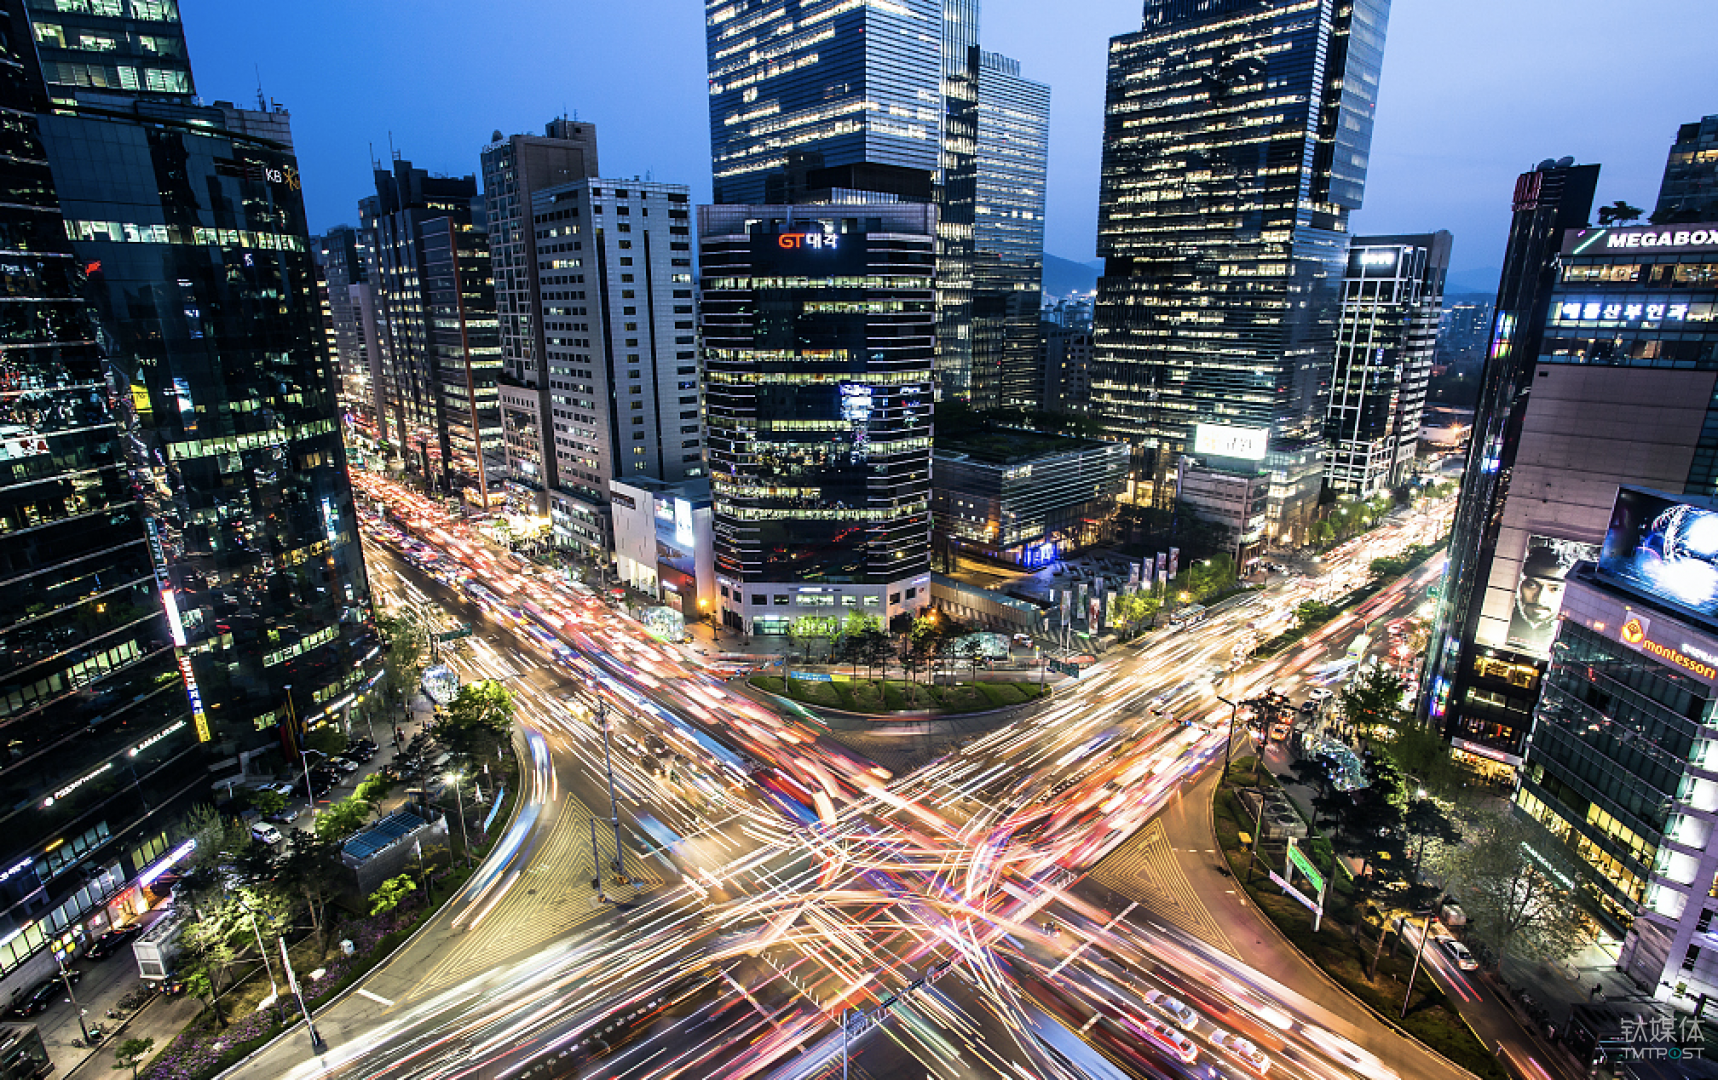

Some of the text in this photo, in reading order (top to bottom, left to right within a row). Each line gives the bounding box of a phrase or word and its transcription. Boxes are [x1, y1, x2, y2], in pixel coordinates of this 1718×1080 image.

[265, 167, 282, 183] KB
[1606, 229, 1718, 249] MEGABOX
[1642, 638, 1717, 680] montessori
